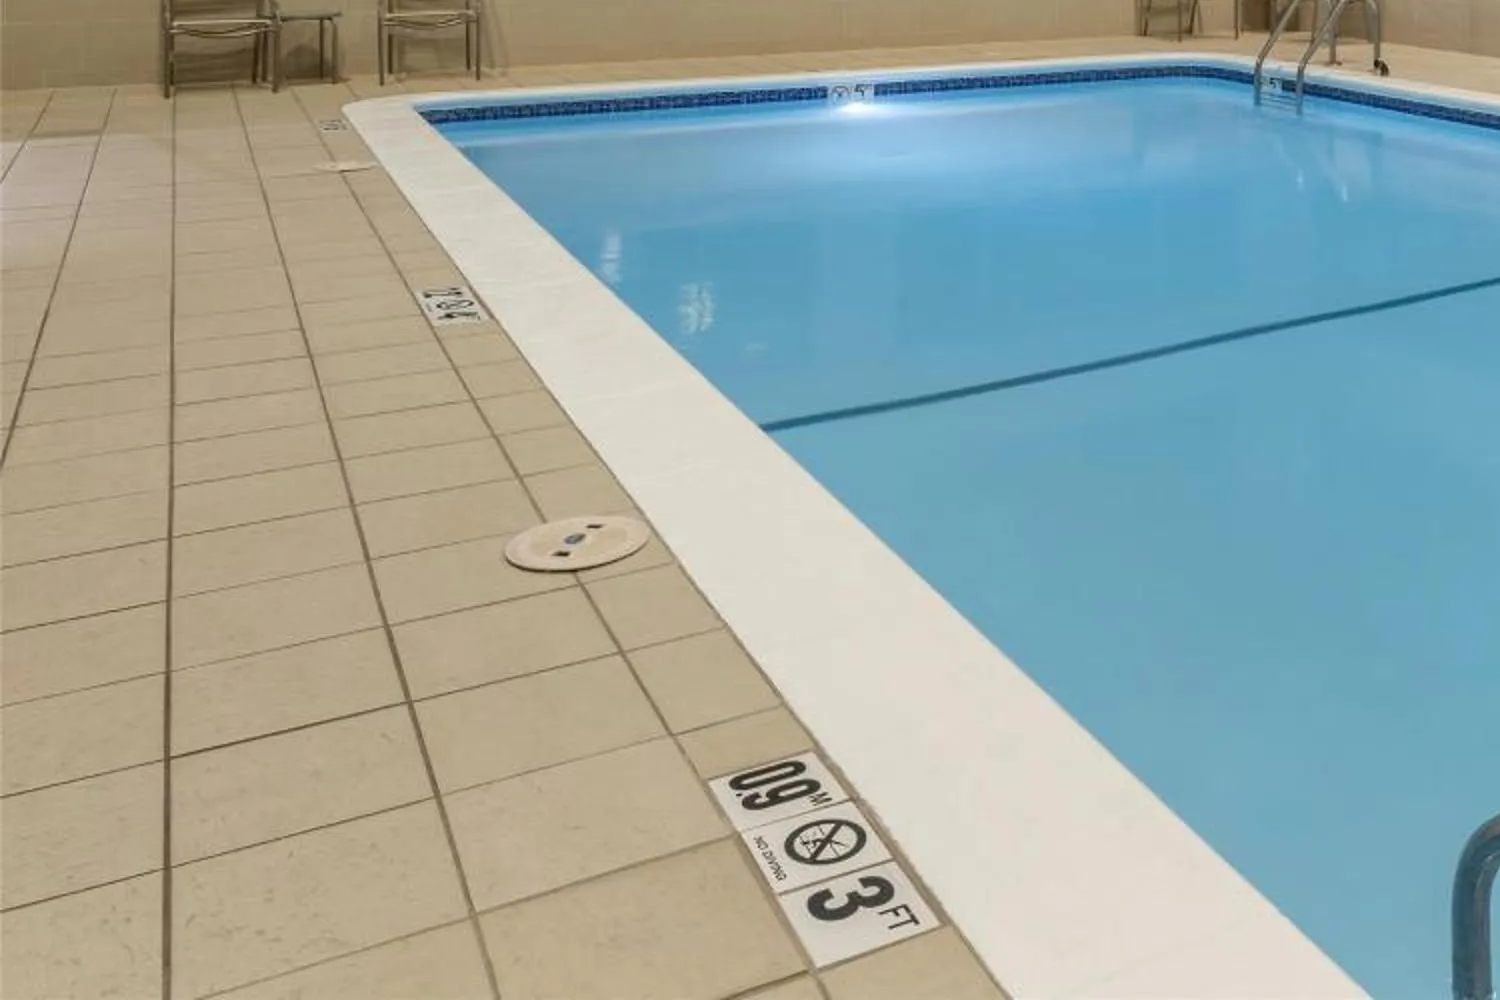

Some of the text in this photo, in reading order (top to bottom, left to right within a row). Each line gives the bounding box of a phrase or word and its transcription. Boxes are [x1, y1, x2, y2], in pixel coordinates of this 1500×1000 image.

[761, 850, 787, 881] DIVING
[806, 875, 920, 930] 3 FT
